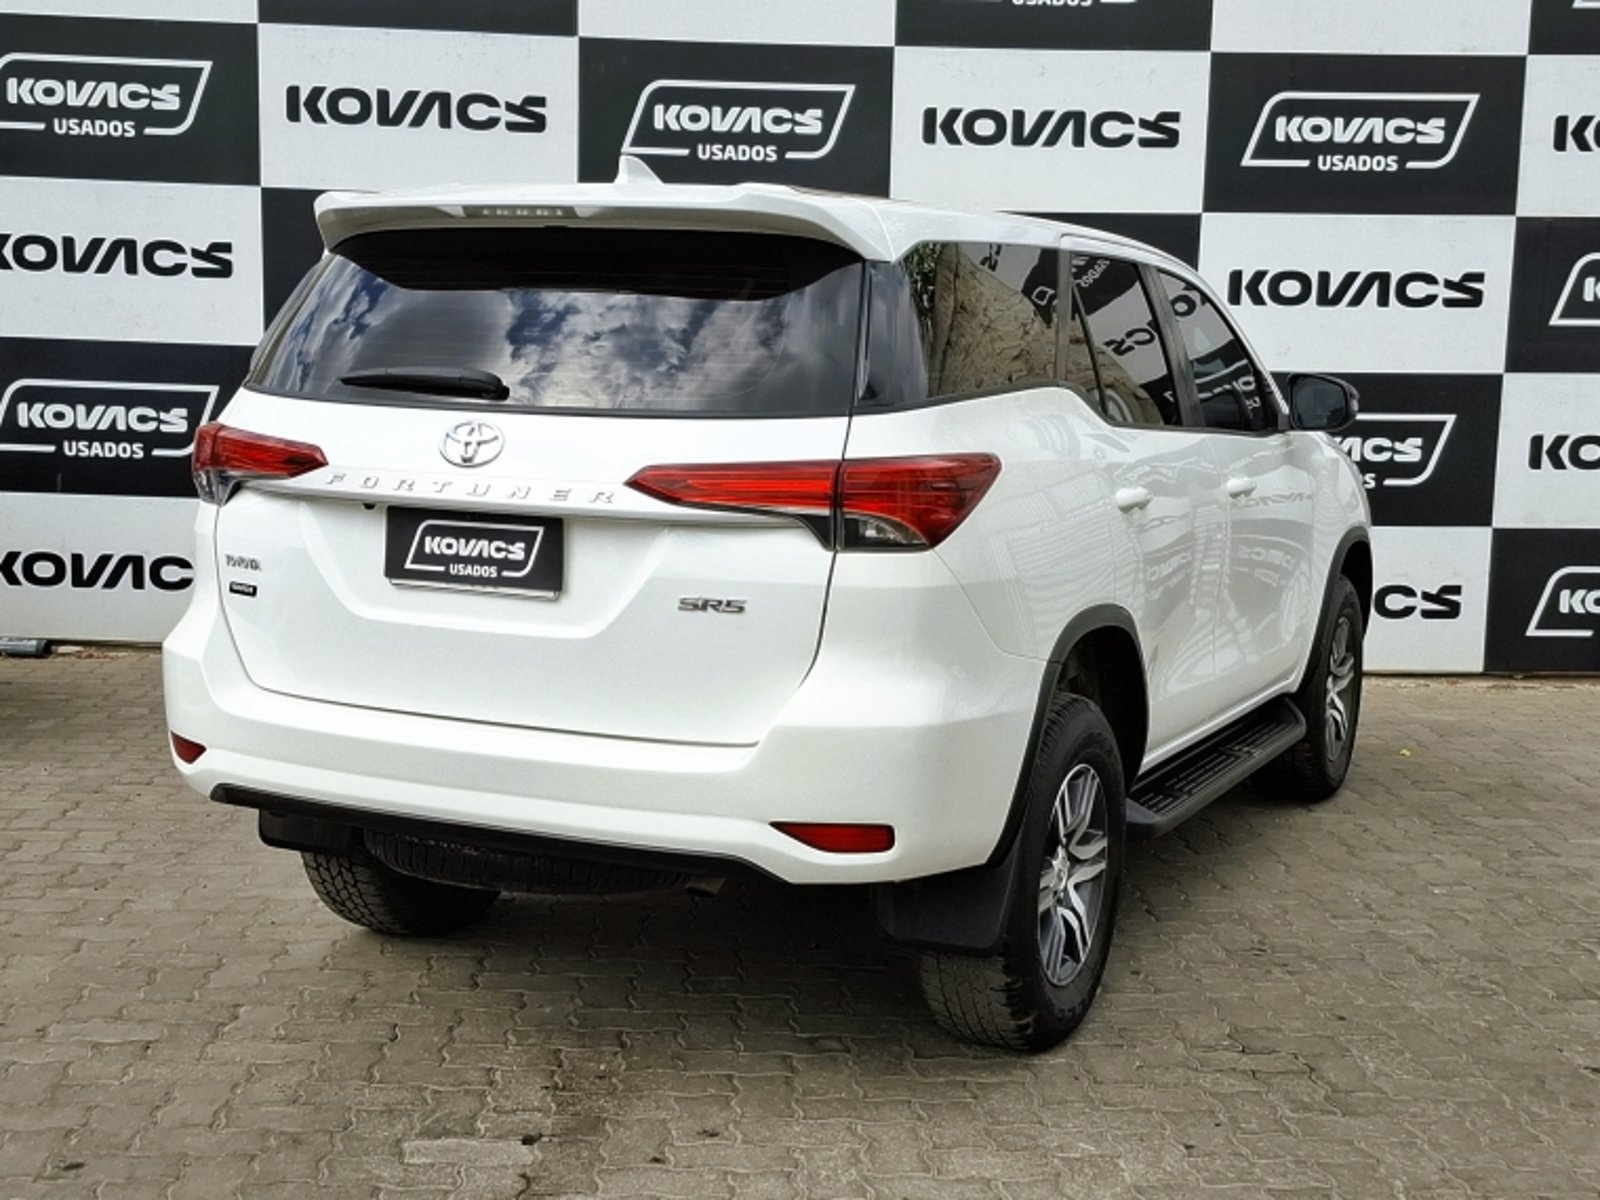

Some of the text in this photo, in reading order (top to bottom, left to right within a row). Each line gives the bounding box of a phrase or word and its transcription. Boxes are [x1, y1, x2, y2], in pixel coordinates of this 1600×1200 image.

[6, 77, 181, 111] KOVACS
[285, 85, 547, 134] KOVACS
[653, 104, 823, 135] KOVACS
[53, 118, 136, 138] USADOS
[922, 107, 1181, 149] KOVACS
[1274, 115, 1446, 144] KOVACS
[1553, 115, 1600, 152] K
[697, 143, 778, 162] USADOS
[1317, 154, 1399, 172] USADOS
[1227, 269, 1485, 309] KOVACS
[16, 402, 188, 433] KOVACS
[63, 440, 144, 459] USADOS
[1334, 437, 1424, 462] ACS
[325, 473, 616, 504] FORTUNER
[424, 536, 526, 561] KOVACS
[449, 563, 498, 578] USADOS
[678, 596, 747, 613] SR5
